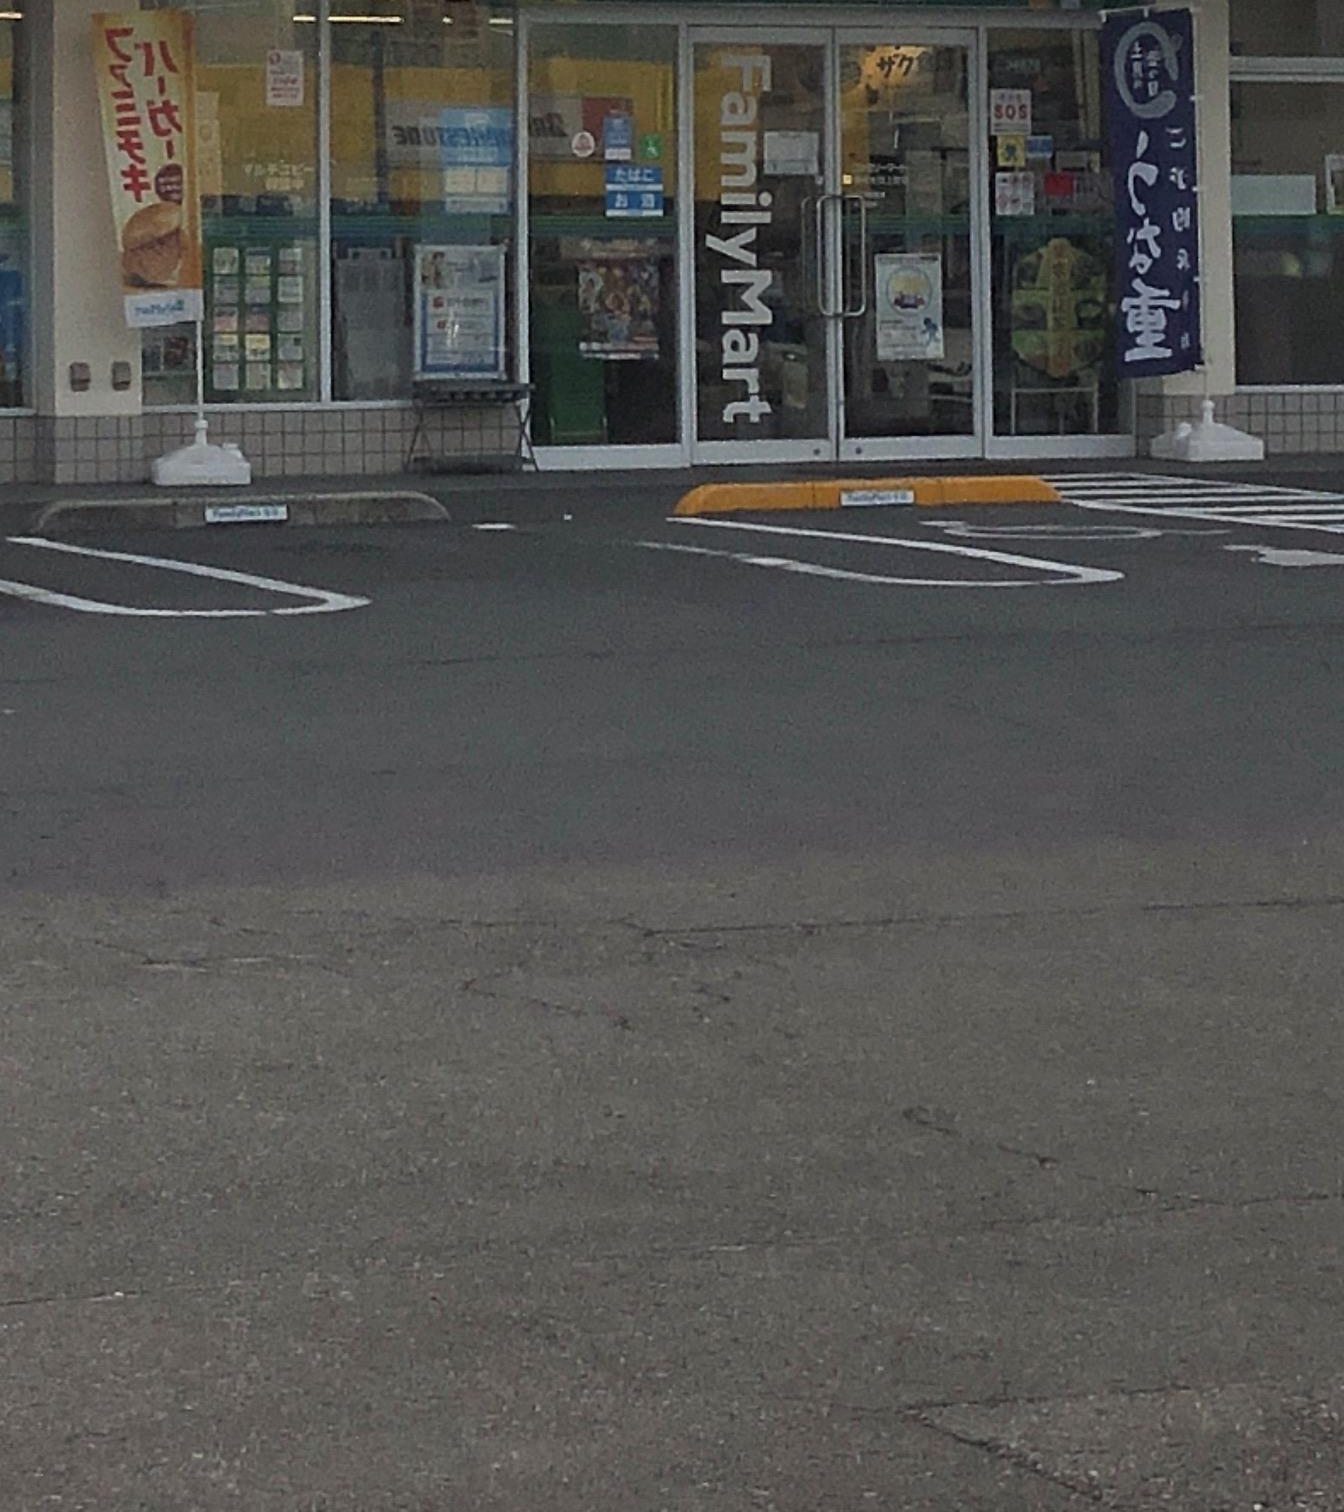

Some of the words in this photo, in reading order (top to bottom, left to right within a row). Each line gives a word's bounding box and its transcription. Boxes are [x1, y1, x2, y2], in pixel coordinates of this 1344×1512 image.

[993, 103, 1029, 121] SOS
[615, 168, 654, 183] たばこ
[705, 54, 773, 424] FamilyMart
